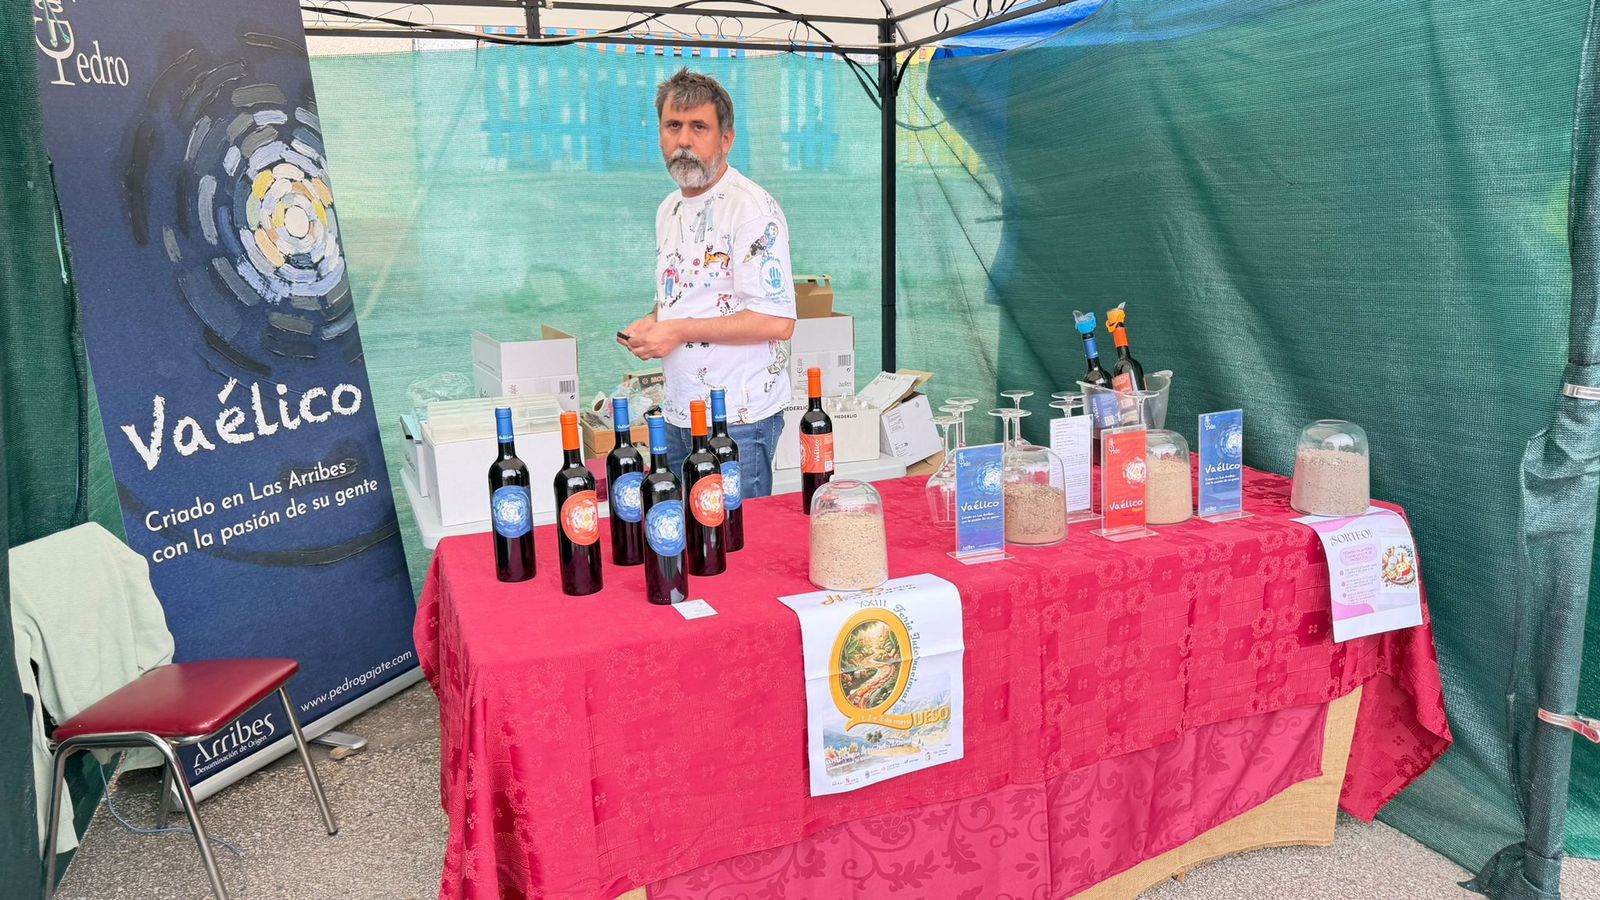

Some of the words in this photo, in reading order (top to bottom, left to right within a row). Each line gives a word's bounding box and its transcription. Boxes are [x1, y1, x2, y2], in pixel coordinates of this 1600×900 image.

[120, 377, 362, 471] Vaélico
[1205, 462, 1241, 474] Vaélico
[146, 496, 215, 532] Criado
[221, 492, 244, 509] en
[249, 482, 282, 501] Las
[289, 461, 347, 489] Arribes
[961, 500, 1000, 512] Vaélico
[1109, 499, 1143, 511] Vaélico
[152, 541, 188, 563] con
[193, 528, 213, 549] la
[220, 510, 280, 545] pasión
[286, 498, 307, 519] de
[312, 494, 330, 510] su
[335, 479, 378, 506] gente
[1329, 529, 1373, 547] ¡SORTEO!
[856, 599, 887, 608] XXIII
[893, 604, 914, 632] Feria
[300, 650, 412, 712] www.pedrogajate.com
[193, 713, 275, 768] Arribes
[194, 750, 239, 776] Denominación
[248, 735, 267, 748] Origen
